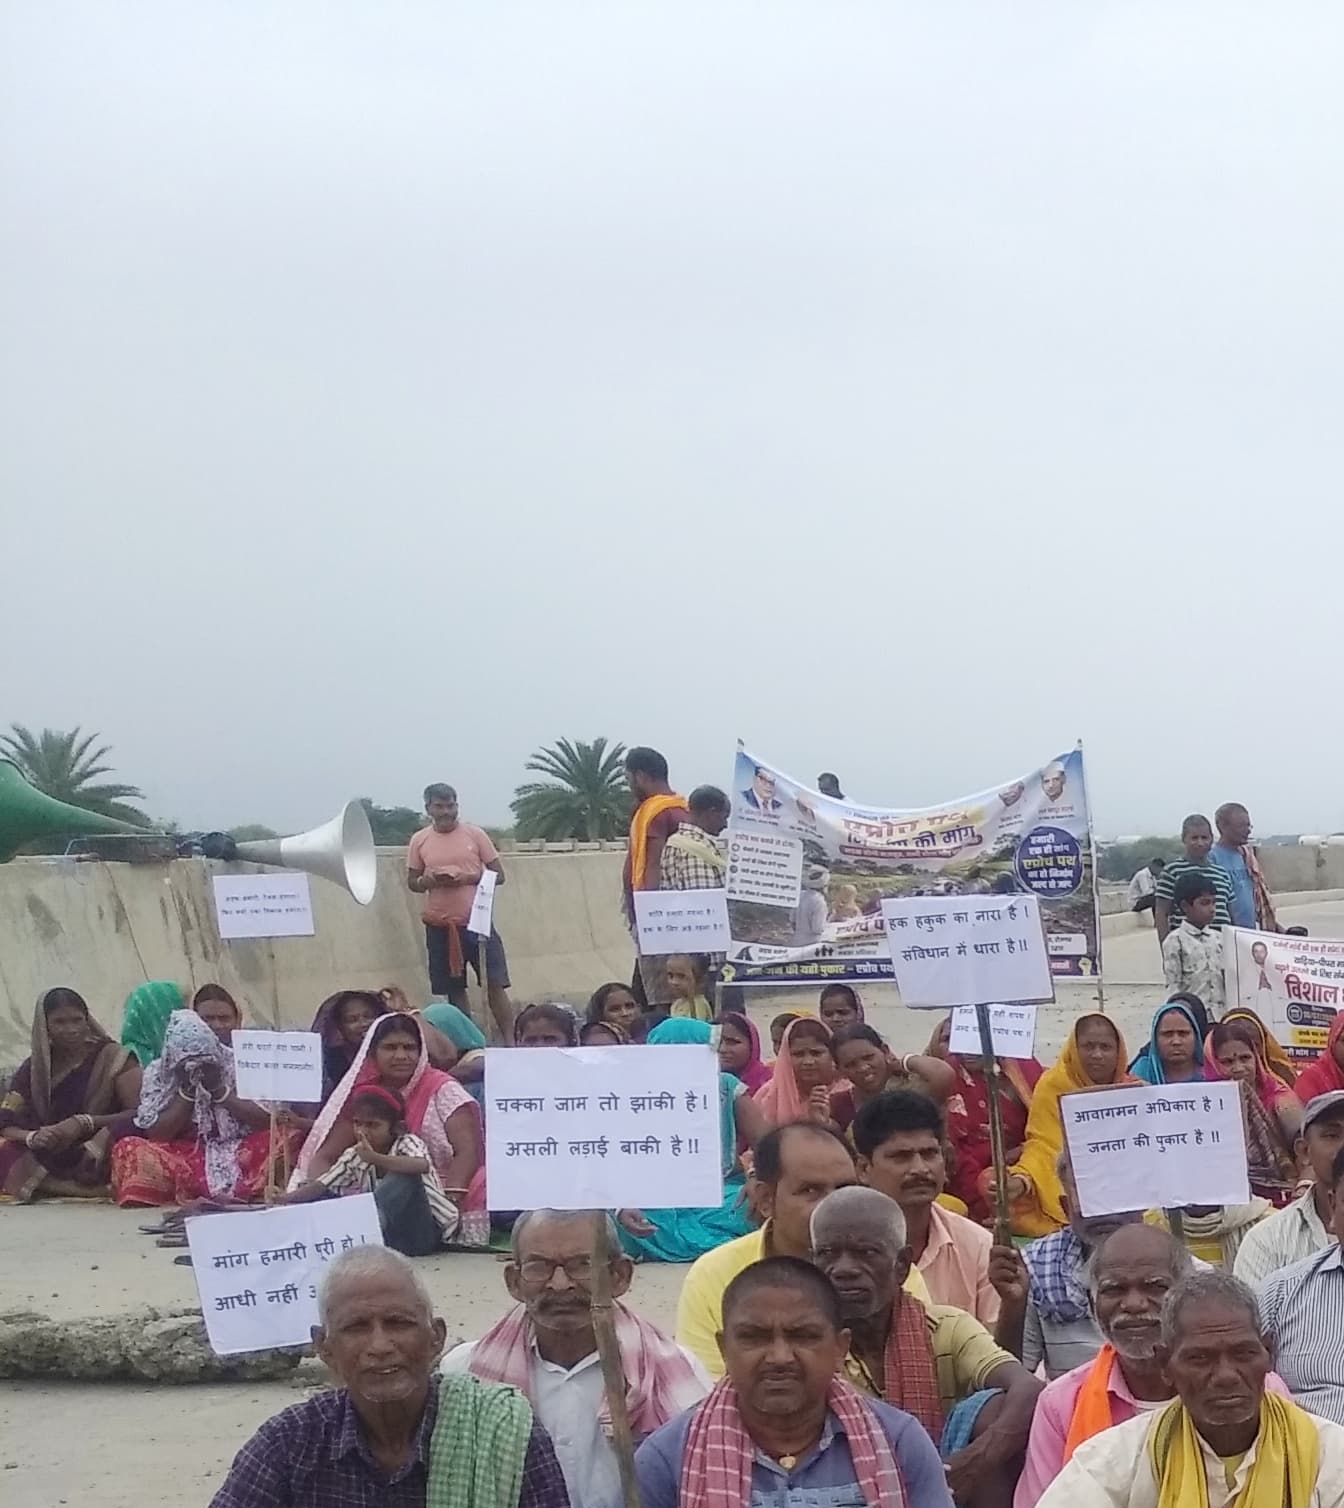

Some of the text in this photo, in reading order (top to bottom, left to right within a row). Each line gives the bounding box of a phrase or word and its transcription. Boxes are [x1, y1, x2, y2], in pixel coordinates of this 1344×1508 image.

[1030, 833, 1055, 844] हमारी
[888, 917, 908, 931] हक
[915, 913, 946, 932] हकुक
[953, 911, 968, 923] का
[975, 909, 1001, 921] नारा
[1008, 905, 1017, 921] है
[902, 945, 950, 962] संविधान
[956, 941, 967, 957] में
[974, 943, 1000, 954] धारा
[1285, 974, 1339, 1004] विशाल
[496, 1097, 544, 1113] चक्का
[555, 1096, 589, 1111] जाम
[599, 1092, 620, 1111] तो
[630, 1091, 675, 1114] झांकी
[1075, 1105, 1138, 1123] आवागमन
[1146, 1099, 1196, 1114] अधिकार
[1202, 1096, 1212, 1112] है
[506, 1137, 559, 1157] असली
[568, 1136, 609, 1158] लड़ाई
[620, 1135, 661, 1155] बाकी
[1087, 1138, 1126, 1154] जनता
[1133, 1132, 1150, 1148] की
[1156, 1133, 1188, 1152] पुकार
[1195, 1129, 1203, 1145] है
[212, 1250, 249, 1269] मांग
[260, 1242, 307, 1266] हमारी
[315, 1237, 335, 1261] पूरी
[215, 1290, 257, 1311] आधी
[266, 1283, 298, 1304] नहीं
